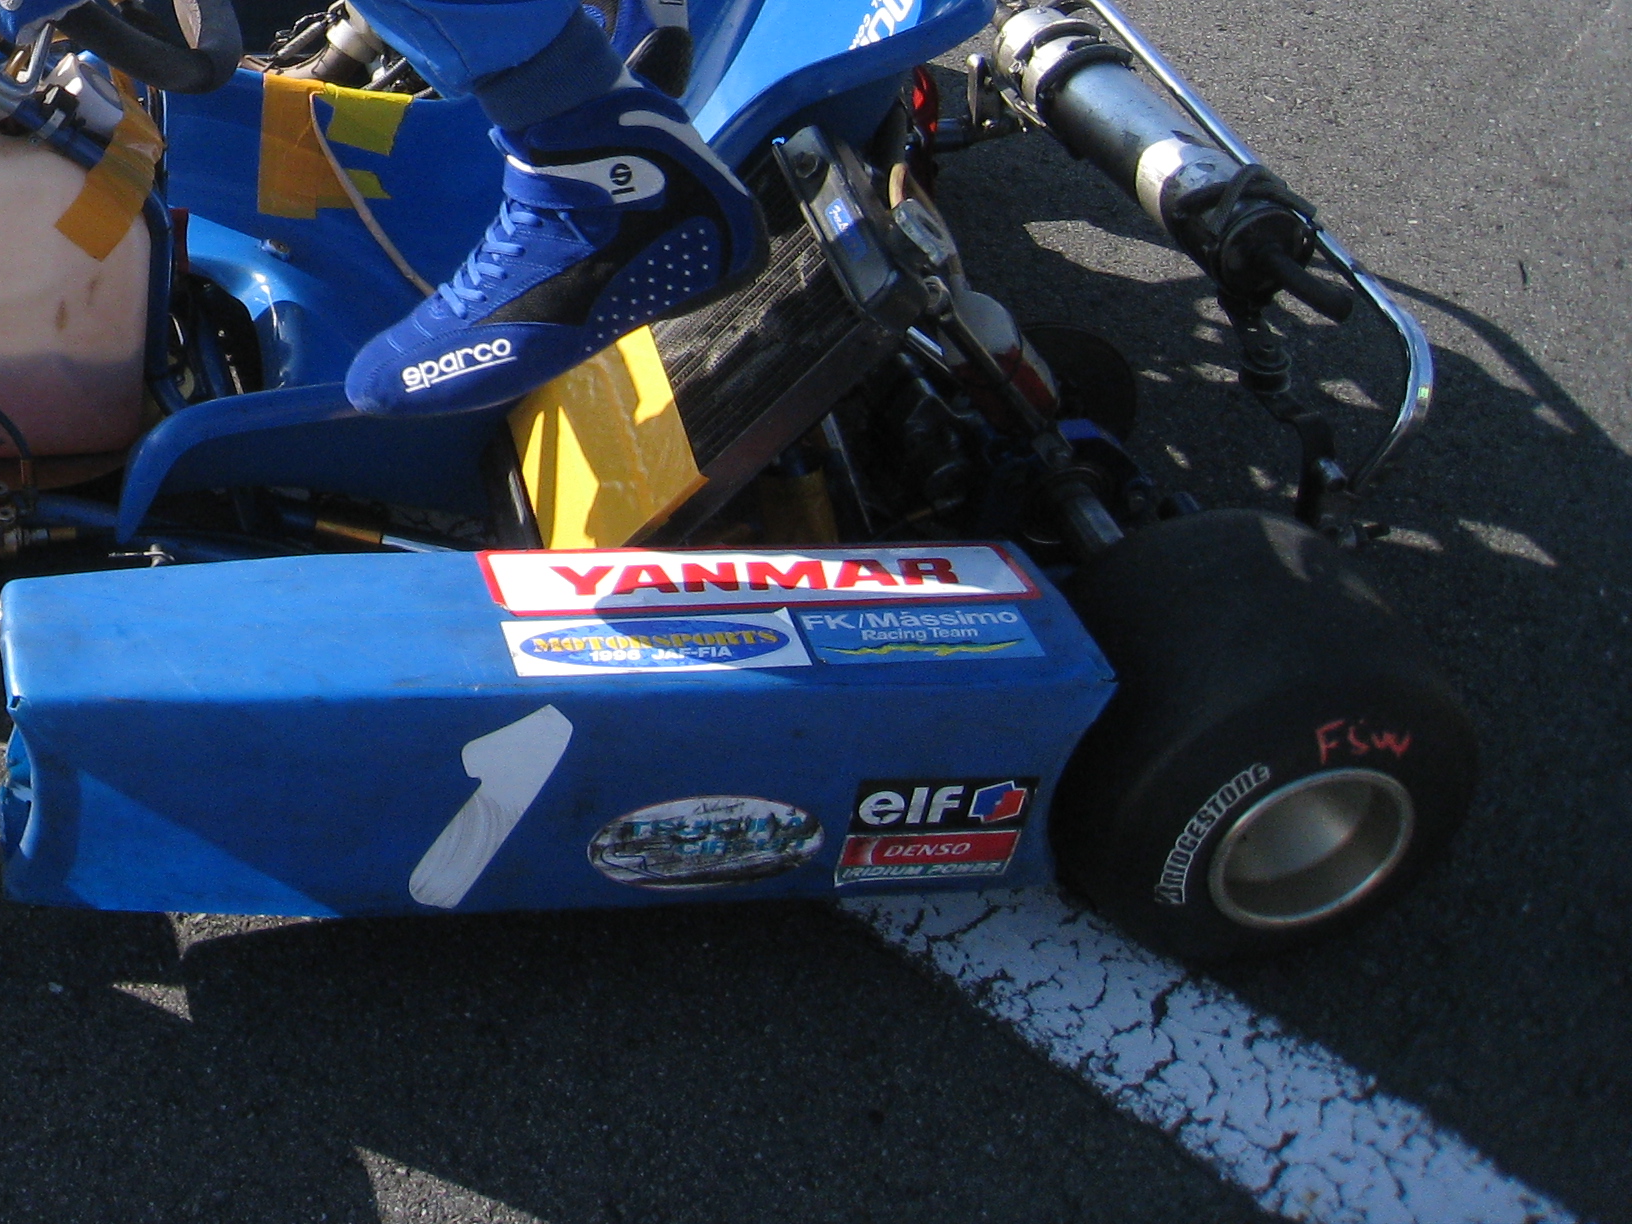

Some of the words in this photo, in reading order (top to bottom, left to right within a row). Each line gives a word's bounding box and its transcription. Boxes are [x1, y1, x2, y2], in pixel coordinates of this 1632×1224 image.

[402, 338, 511, 388] sparco
[550, 559, 960, 596] YANMAR
[533, 630, 780, 652] MOTORSPORTS
[861, 628, 927, 643] Racing
[931, 626, 979, 638] Team
[651, 646, 733, 660] JAF-FIA
[408, 704, 574, 909] 1
[859, 786, 964, 825] elf
[1155, 763, 1270, 903] BRIDGESTONE
[884, 843, 971, 857] DENSO
[842, 865, 923, 878] IRIDIUM
[927, 862, 1000, 874] POWER
